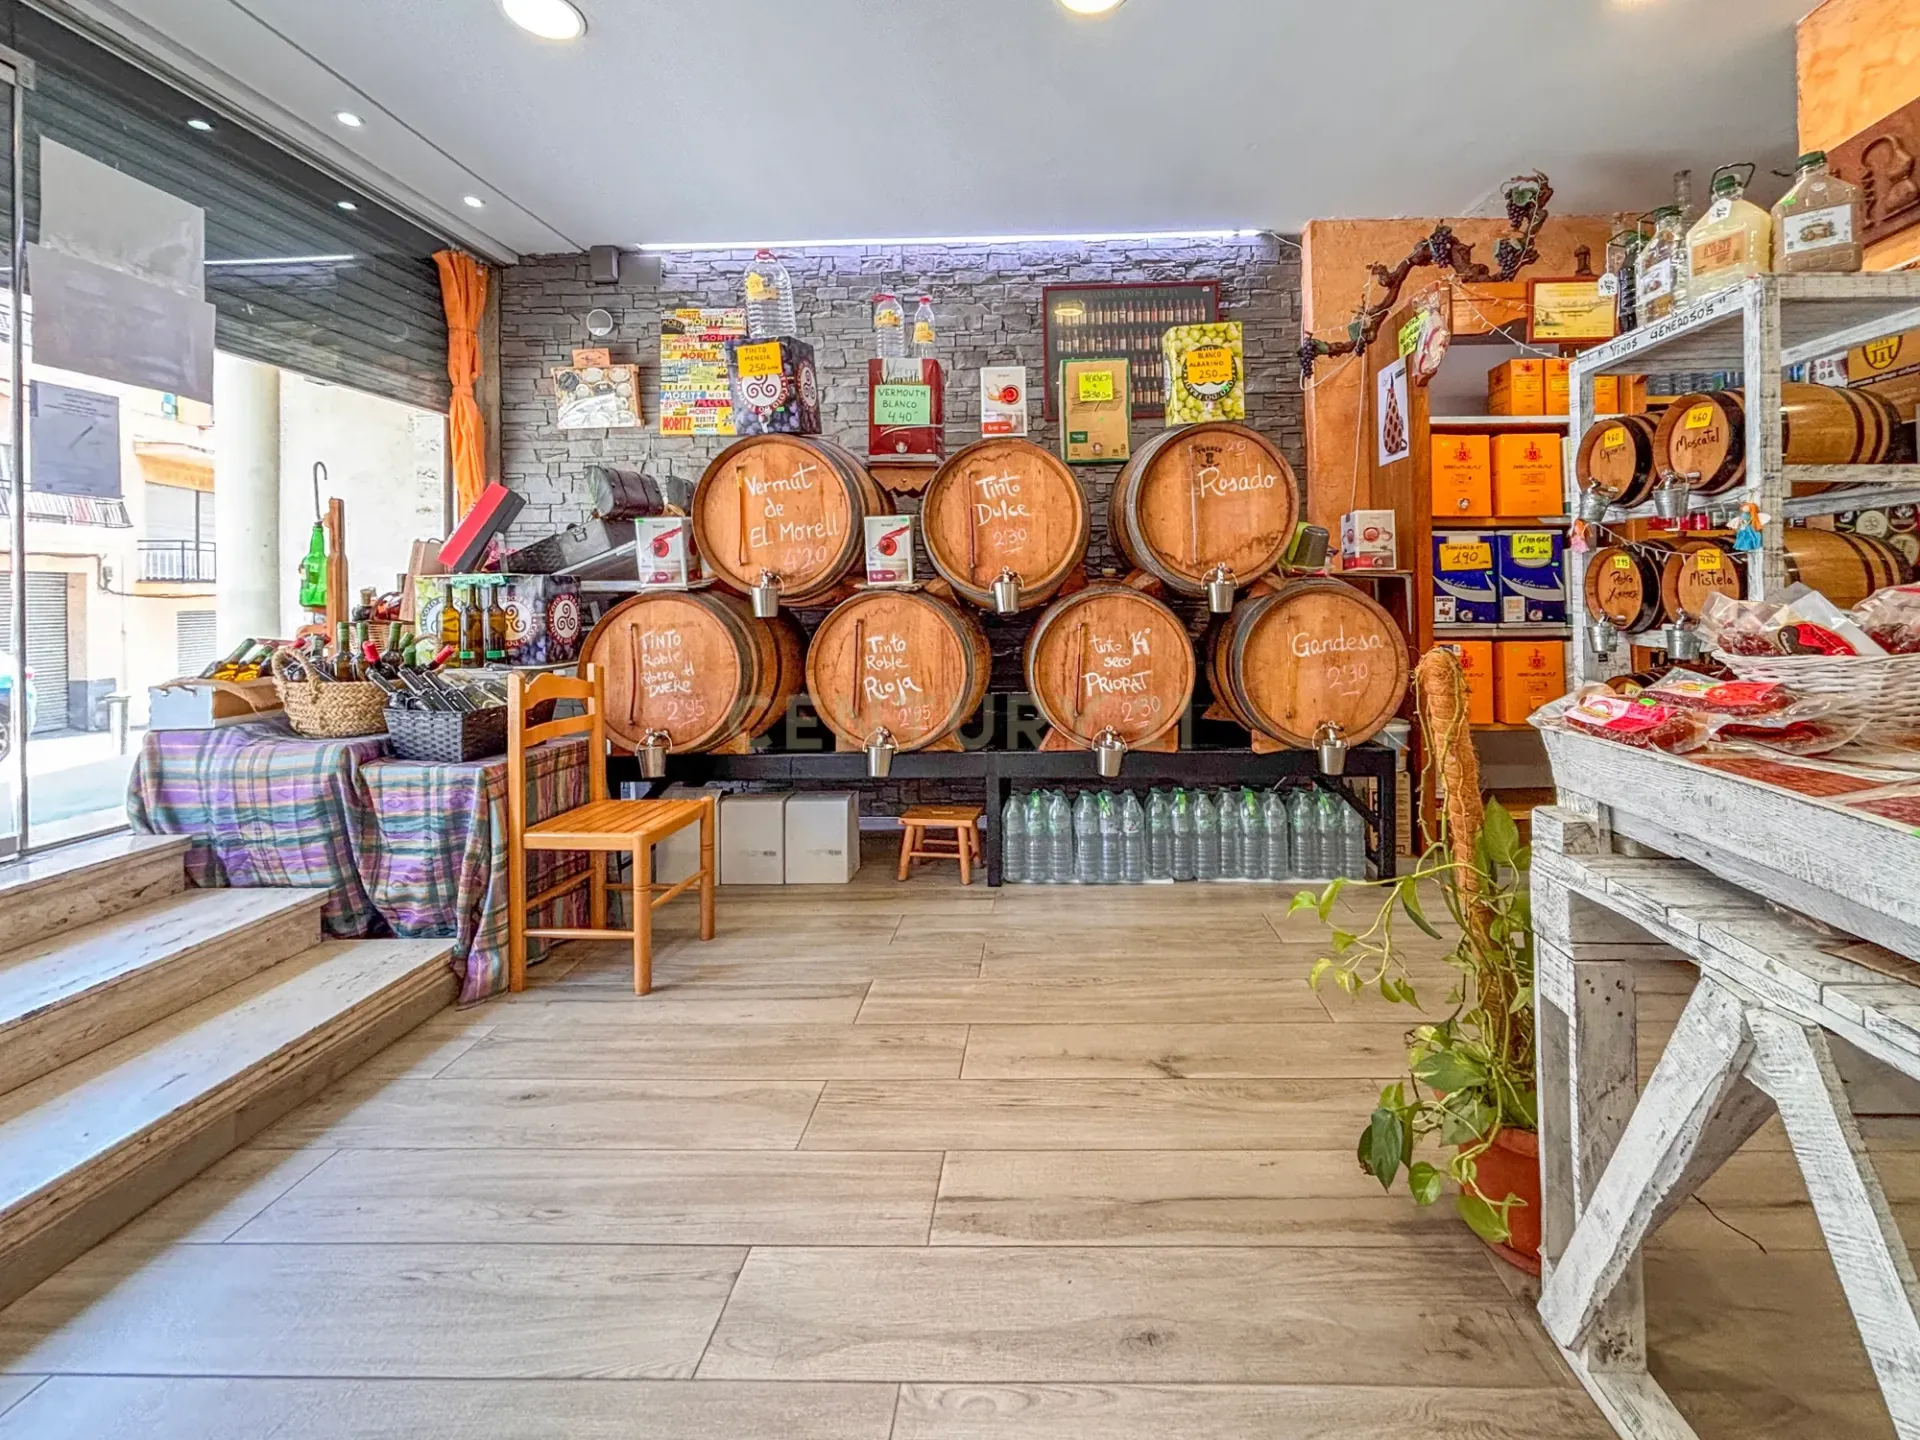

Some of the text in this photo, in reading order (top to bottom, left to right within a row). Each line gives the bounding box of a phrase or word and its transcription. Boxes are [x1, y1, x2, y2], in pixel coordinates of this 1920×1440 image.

[680, 351, 718, 359] MORITZ
[744, 346, 767, 354] TINTO
[1197, 351, 1222, 359] BLANCO
[877, 388, 927, 397] VERMOUTH
[882, 400, 917, 409] BLANCO
[662, 416, 692, 431] MORITZ
[1675, 427, 1720, 452] Moscatel
[744, 462, 817, 496] Vermut
[974, 469, 1021, 500] Tinto
[1198, 463, 1278, 498] Rosado
[764, 497, 785, 518] de
[974, 499, 1031, 527] Dulce
[780, 512, 840, 543] Morell
[1690, 569, 1735, 587] Mistela
[865, 633, 907, 654] Tinto
[1291, 623, 1385, 657] Gandesa
[641, 650, 681, 668] Roble
[865, 654, 909, 671] Roble
[1103, 656, 1132, 668] seco
[863, 673, 923, 706] Rioja
